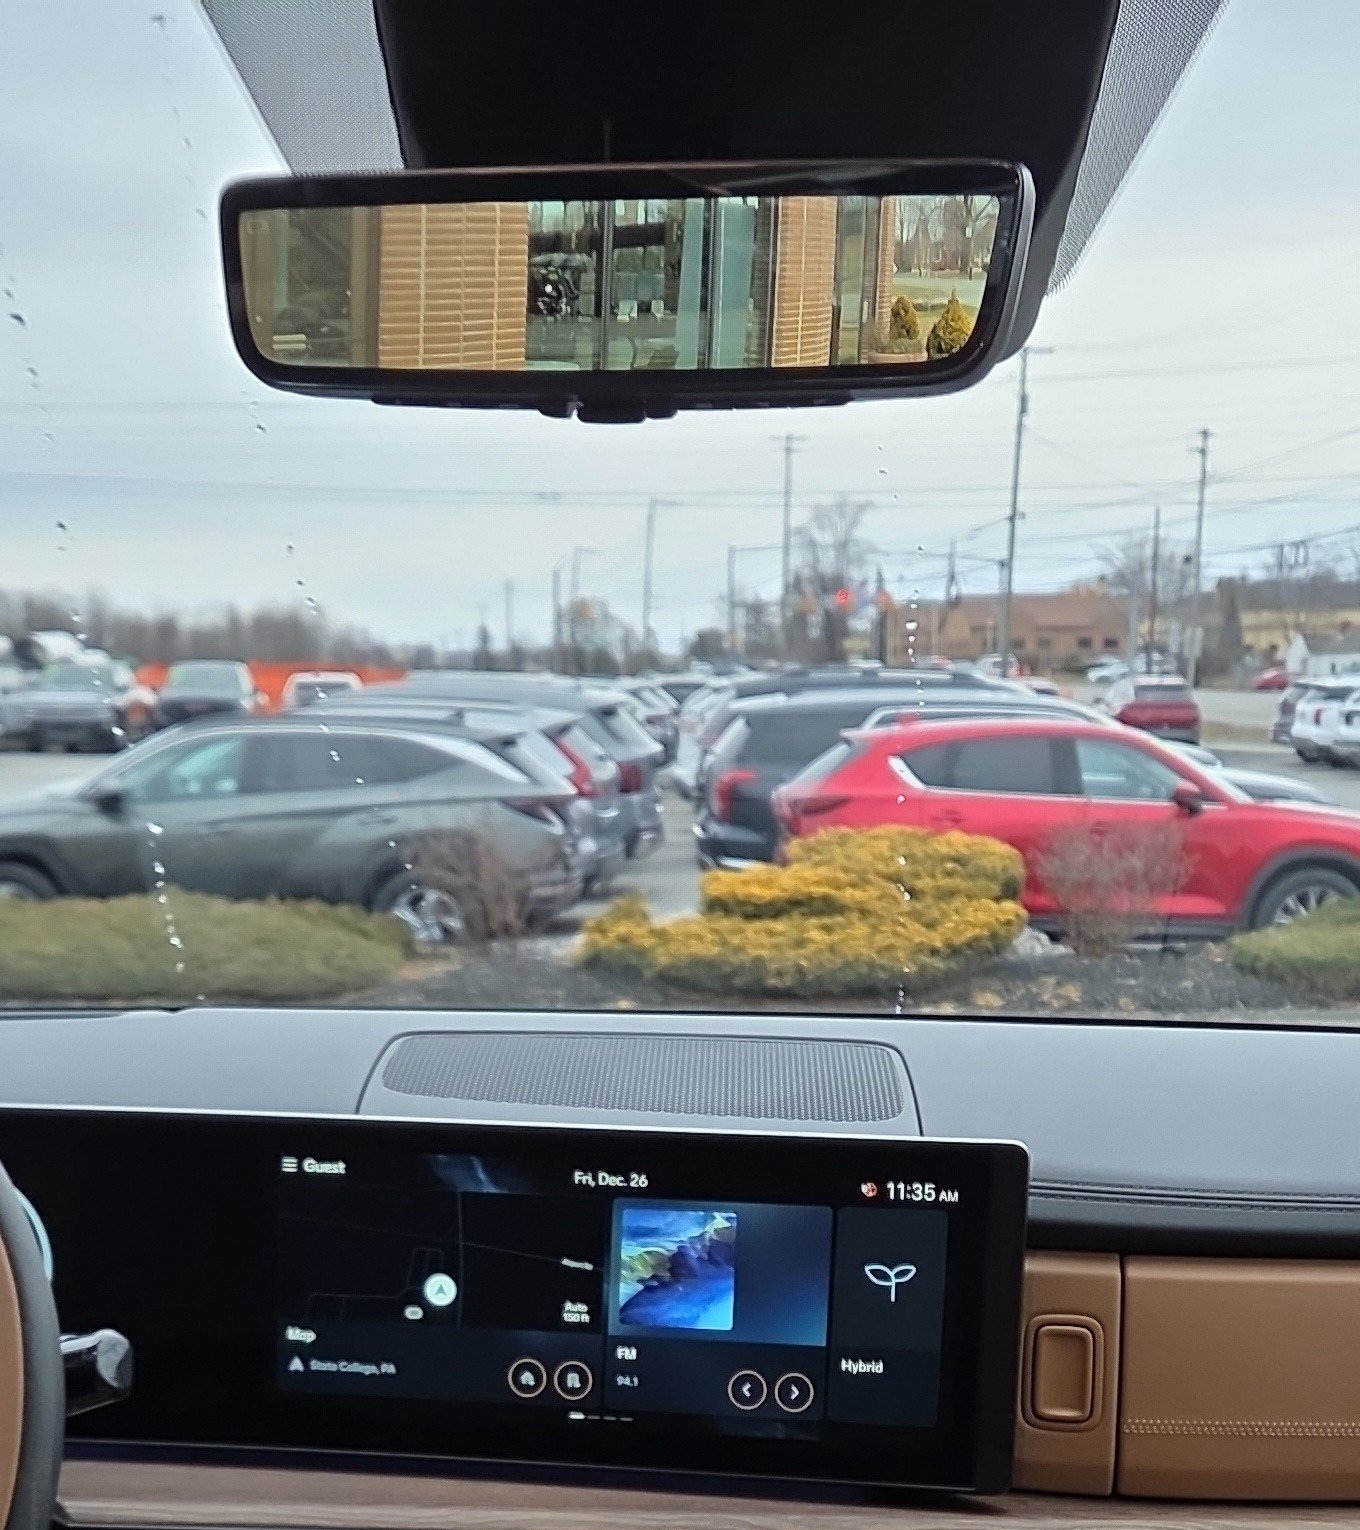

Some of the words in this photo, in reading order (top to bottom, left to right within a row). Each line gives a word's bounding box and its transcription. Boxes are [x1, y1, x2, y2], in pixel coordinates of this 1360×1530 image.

[302, 1157, 347, 1174] Guest
[573, 1169, 596, 1188] Fri,
[597, 1170, 628, 1187] Dec.
[629, 1172, 649, 1188] 26
[886, 1180, 936, 1202] 11:35
[938, 1188, 959, 1203] AM
[285, 1326, 317, 1344] Map
[616, 1345, 638, 1360] FM
[840, 1357, 884, 1375] Hybrid
